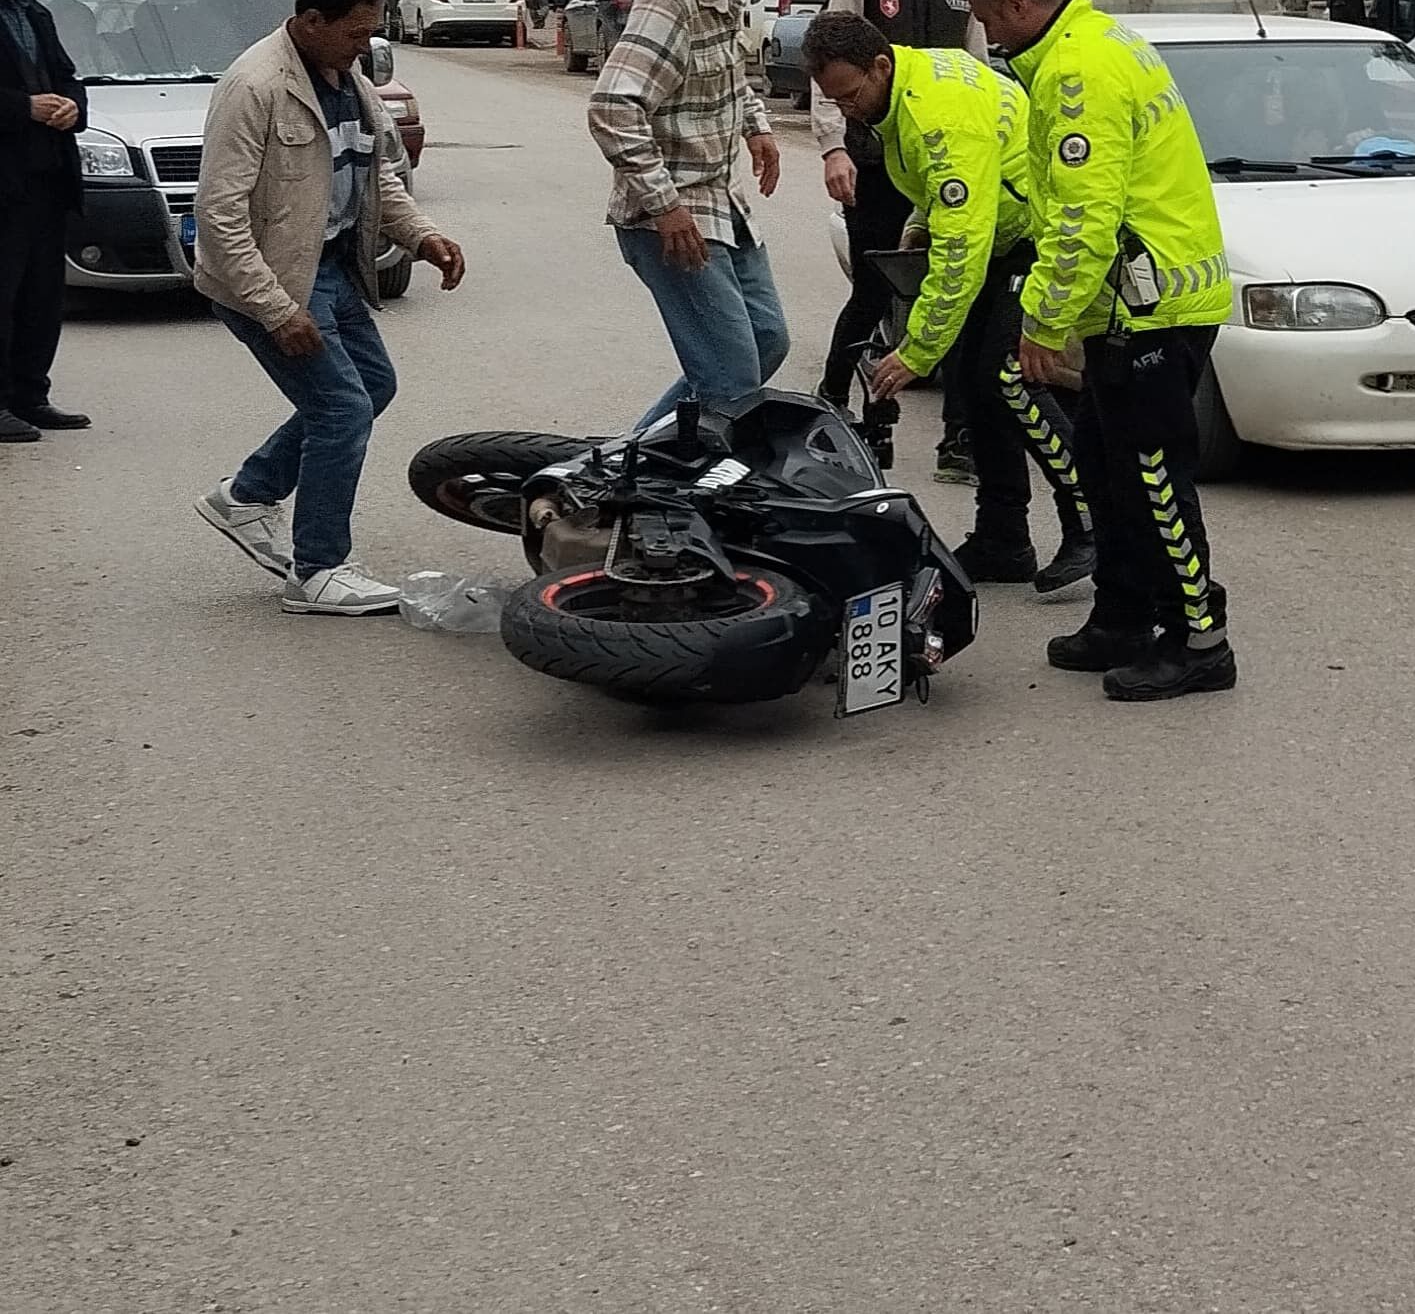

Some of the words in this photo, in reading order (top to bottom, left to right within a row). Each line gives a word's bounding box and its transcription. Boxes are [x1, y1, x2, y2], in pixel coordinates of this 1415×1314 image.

[877, 596, 899, 628] 10
[850, 622, 873, 681] 888
[876, 642, 898, 696] AKY
